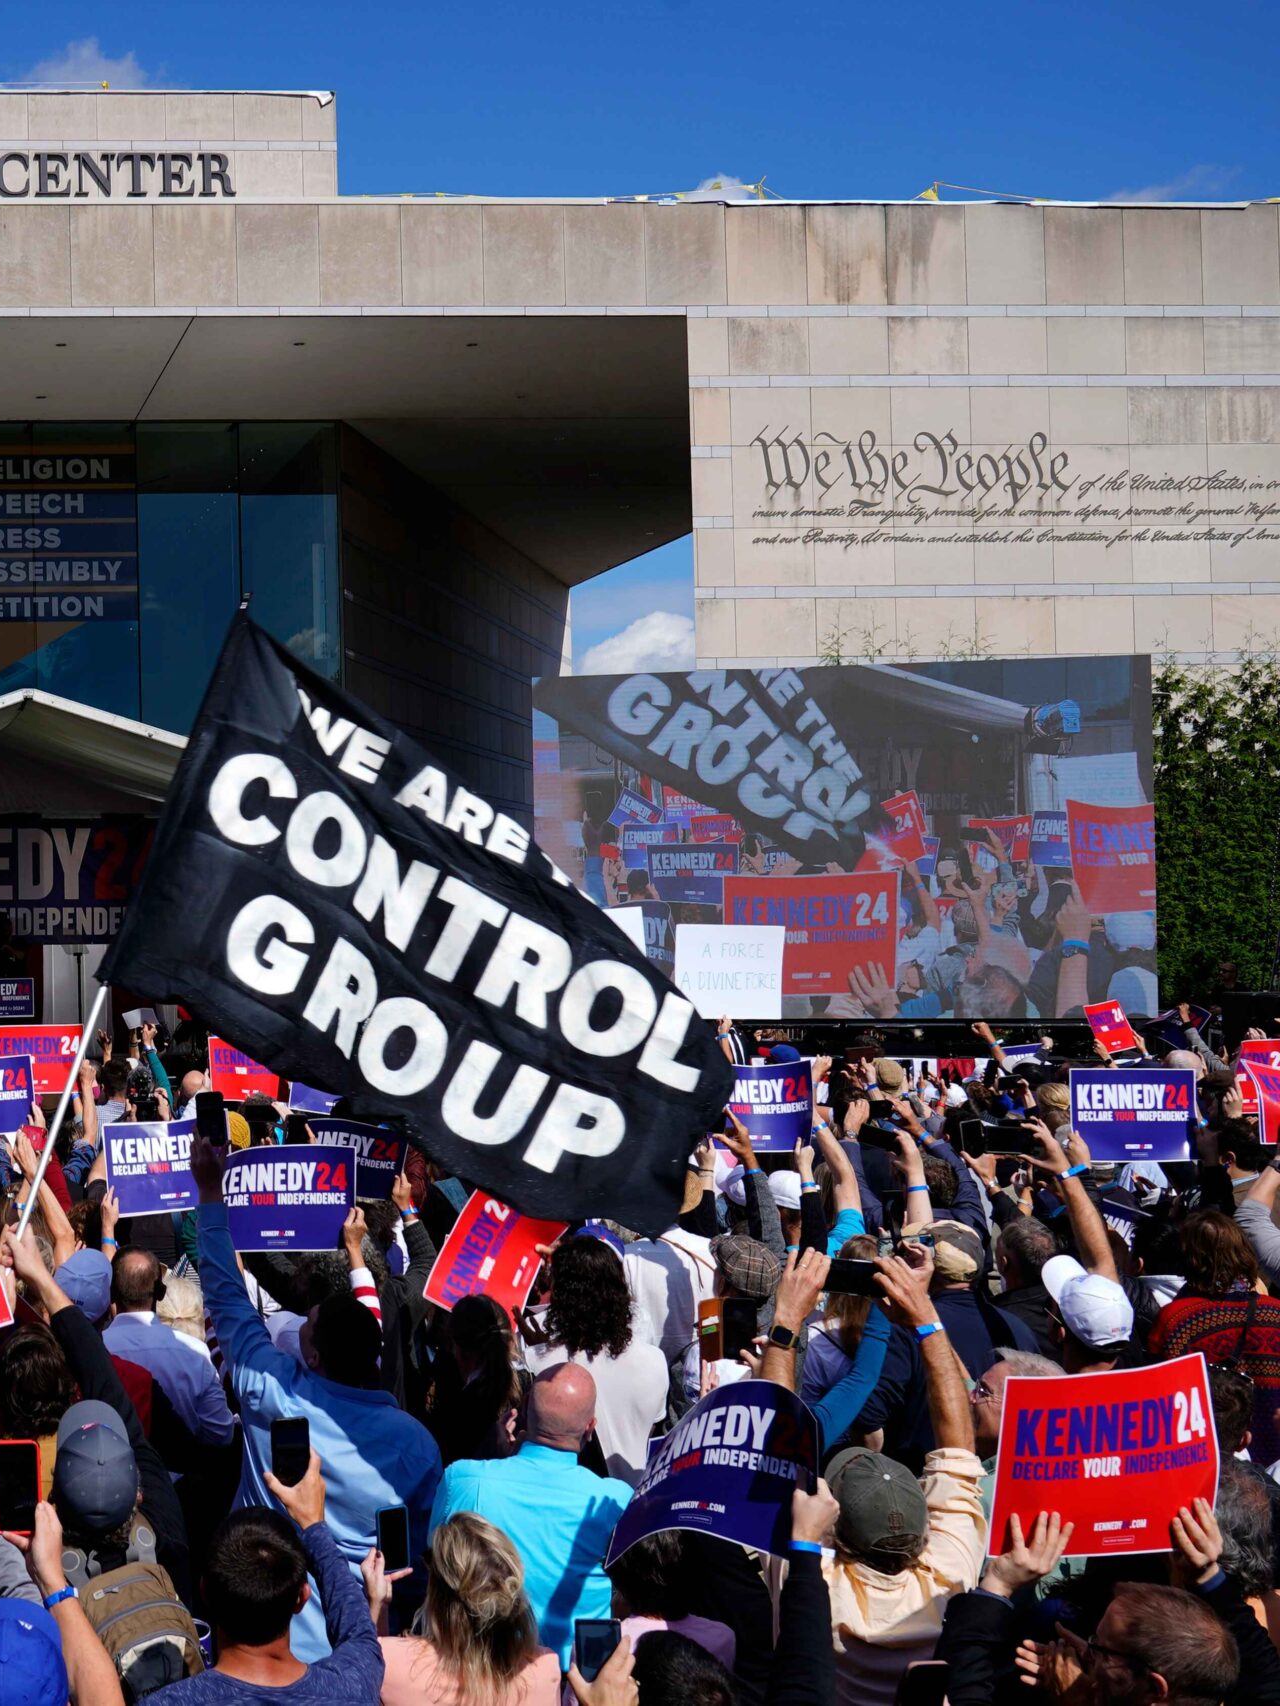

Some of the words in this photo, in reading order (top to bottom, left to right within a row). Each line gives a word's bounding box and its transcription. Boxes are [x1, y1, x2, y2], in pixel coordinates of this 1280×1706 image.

[749, 425, 848, 500] We
[842, 429, 922, 508] the
[906, 427, 1080, 508] People
[297, 688, 393, 786] WE
[391, 764, 532, 866] ARE
[207, 752, 704, 1094] CONTROL
[225, 893, 628, 1175] GROUP
[752, 1100, 809, 1115] INDEPENDENCE
[1076, 1083, 1190, 1110] KENNEDY24
[1077, 1110, 1114, 1122] DECLARE
[1114, 1111, 1135, 1122] YOUR
[1136, 1110, 1190, 1122] INDEPENDENCE
[112, 1162, 147, 1177] DECLARE
[149, 1161, 170, 1174] YOUR
[221, 1161, 348, 1196] KENNEDY24
[251, 1193, 276, 1207] YOUR
[277, 1192, 347, 1206] INDEPENDENCE
[1013, 1386, 1206, 1457] KENNEDY24
[1011, 1459, 1079, 1481] DECLARE
[1083, 1456, 1122, 1479] YOUR
[1124, 1441, 1209, 1475] INDEPENDENCE
[670, 1500, 726, 1514] KENNEDY24.COM
